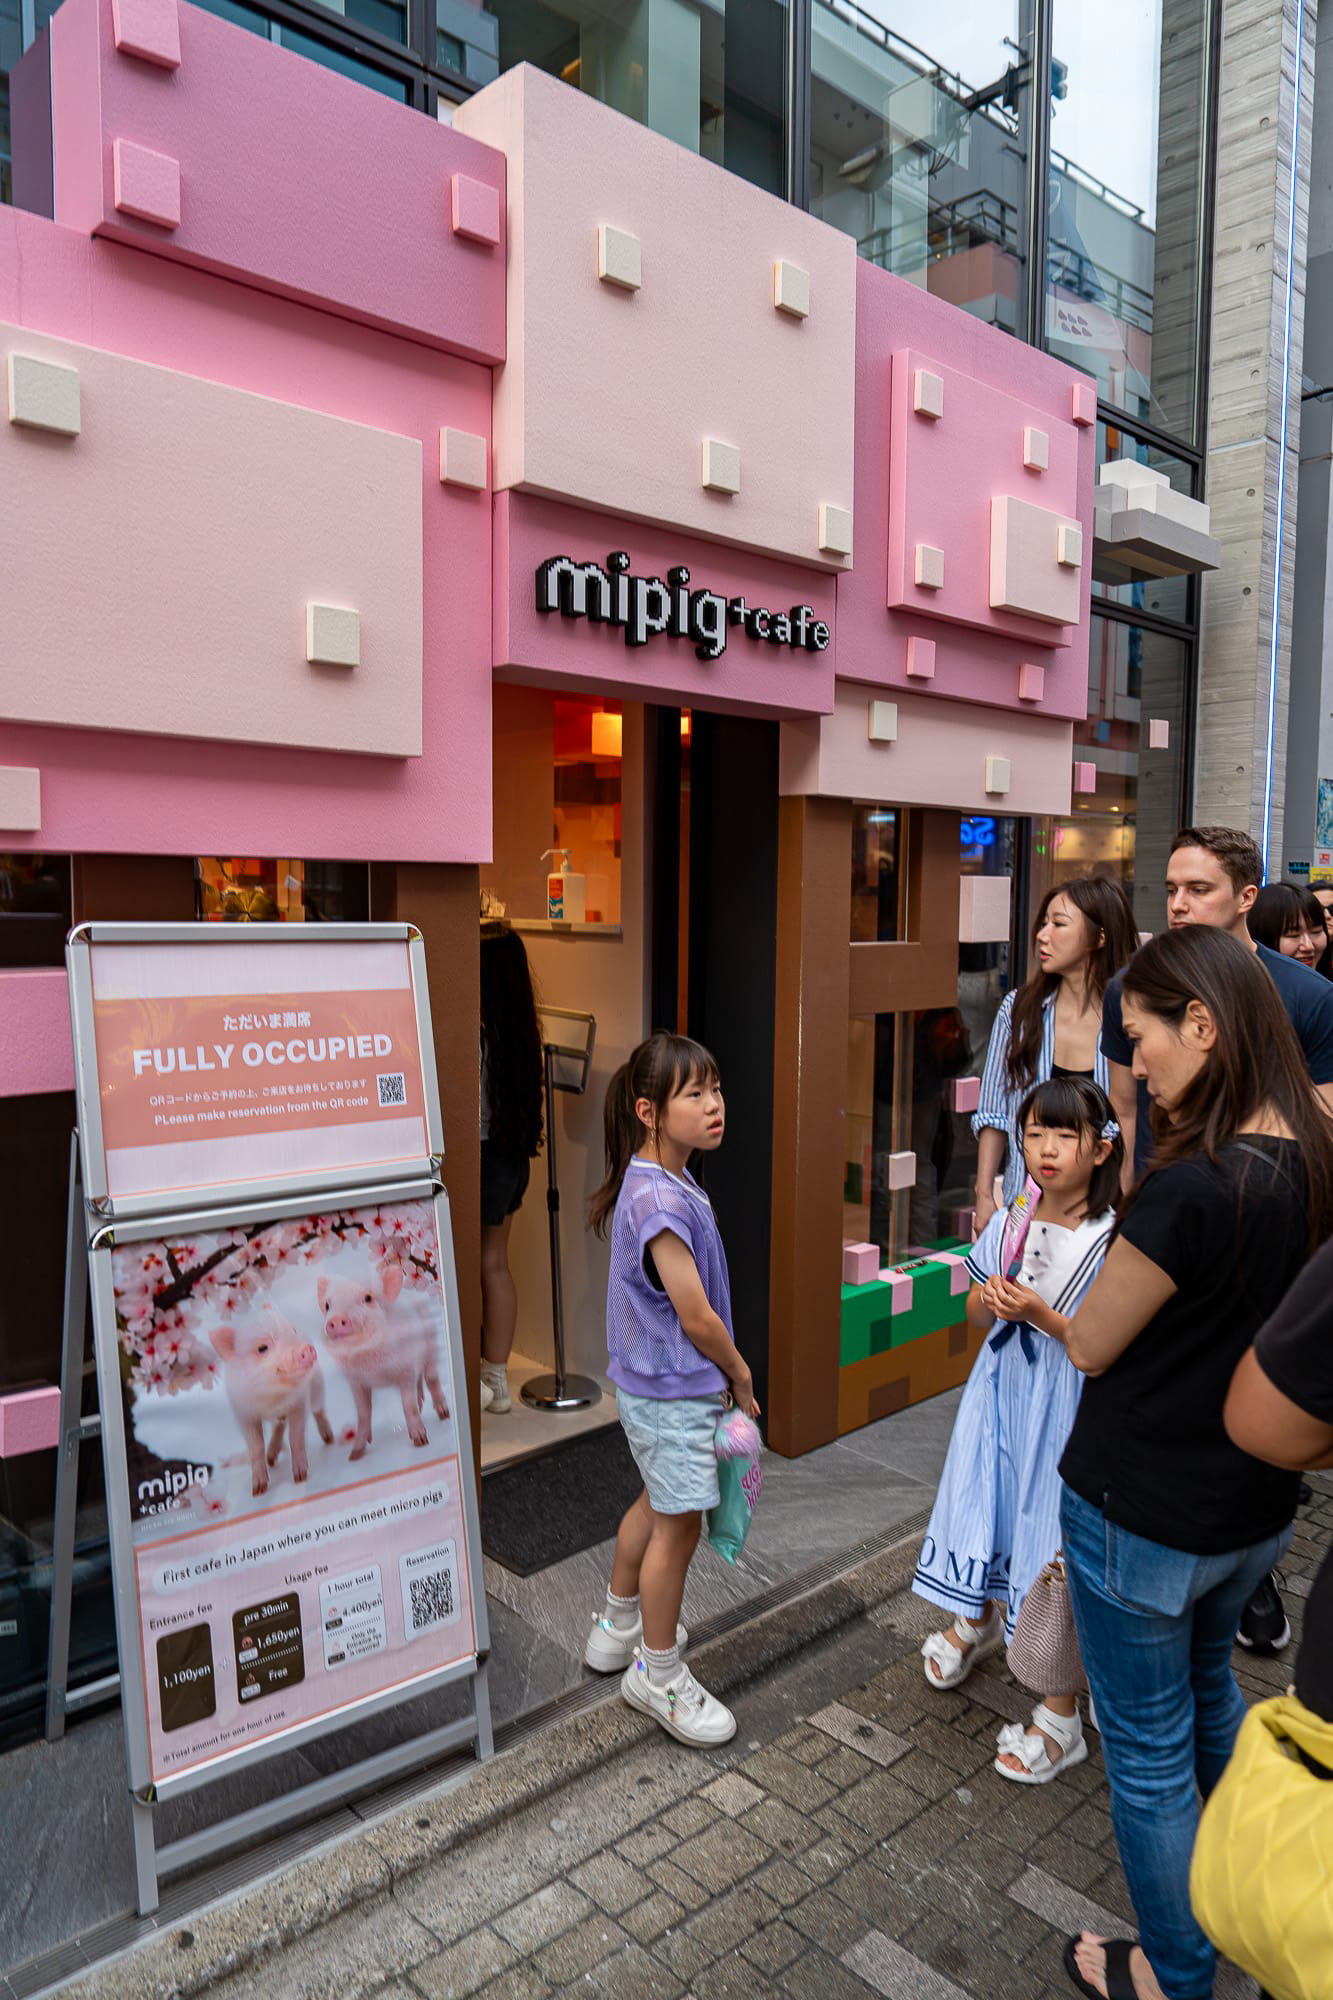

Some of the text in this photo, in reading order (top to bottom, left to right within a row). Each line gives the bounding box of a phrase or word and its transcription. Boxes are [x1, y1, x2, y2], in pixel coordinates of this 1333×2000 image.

[223, 1011, 312, 1031] ただいま満席
[133, 1034, 393, 1076] FULLY OCCUPIED
[197, 1109, 226, 1122] make
[228, 1103, 285, 1120] reservation
[287, 1101, 310, 1114] from
[312, 1099, 328, 1111] the
[330, 1097, 344, 1110] QR
[346, 1095, 369, 1108] code
[138, 1463, 209, 1500] mipig
[163, 1490, 444, 1585] First cafe in Japan where you can meet micro pigs
[405, 1546, 450, 1568] Reservation
[284, 1564, 329, 1586] Usage fee
[334, 1579, 353, 1593] hour
[355, 1571, 374, 1585] total
[150, 1603, 213, 1631] Entrance fee
[243, 1600, 289, 1626] pre 30min
[163, 1664, 211, 1689] 1,100yen
[268, 1666, 288, 1682] Free
[192, 1736, 218, 1753] amount
[220, 1732, 230, 1743] for
[232, 1727, 246, 1737] one
[247, 1719, 263, 1731] hour
[264, 1715, 272, 1725] of
[273, 1711, 286, 1721] use
